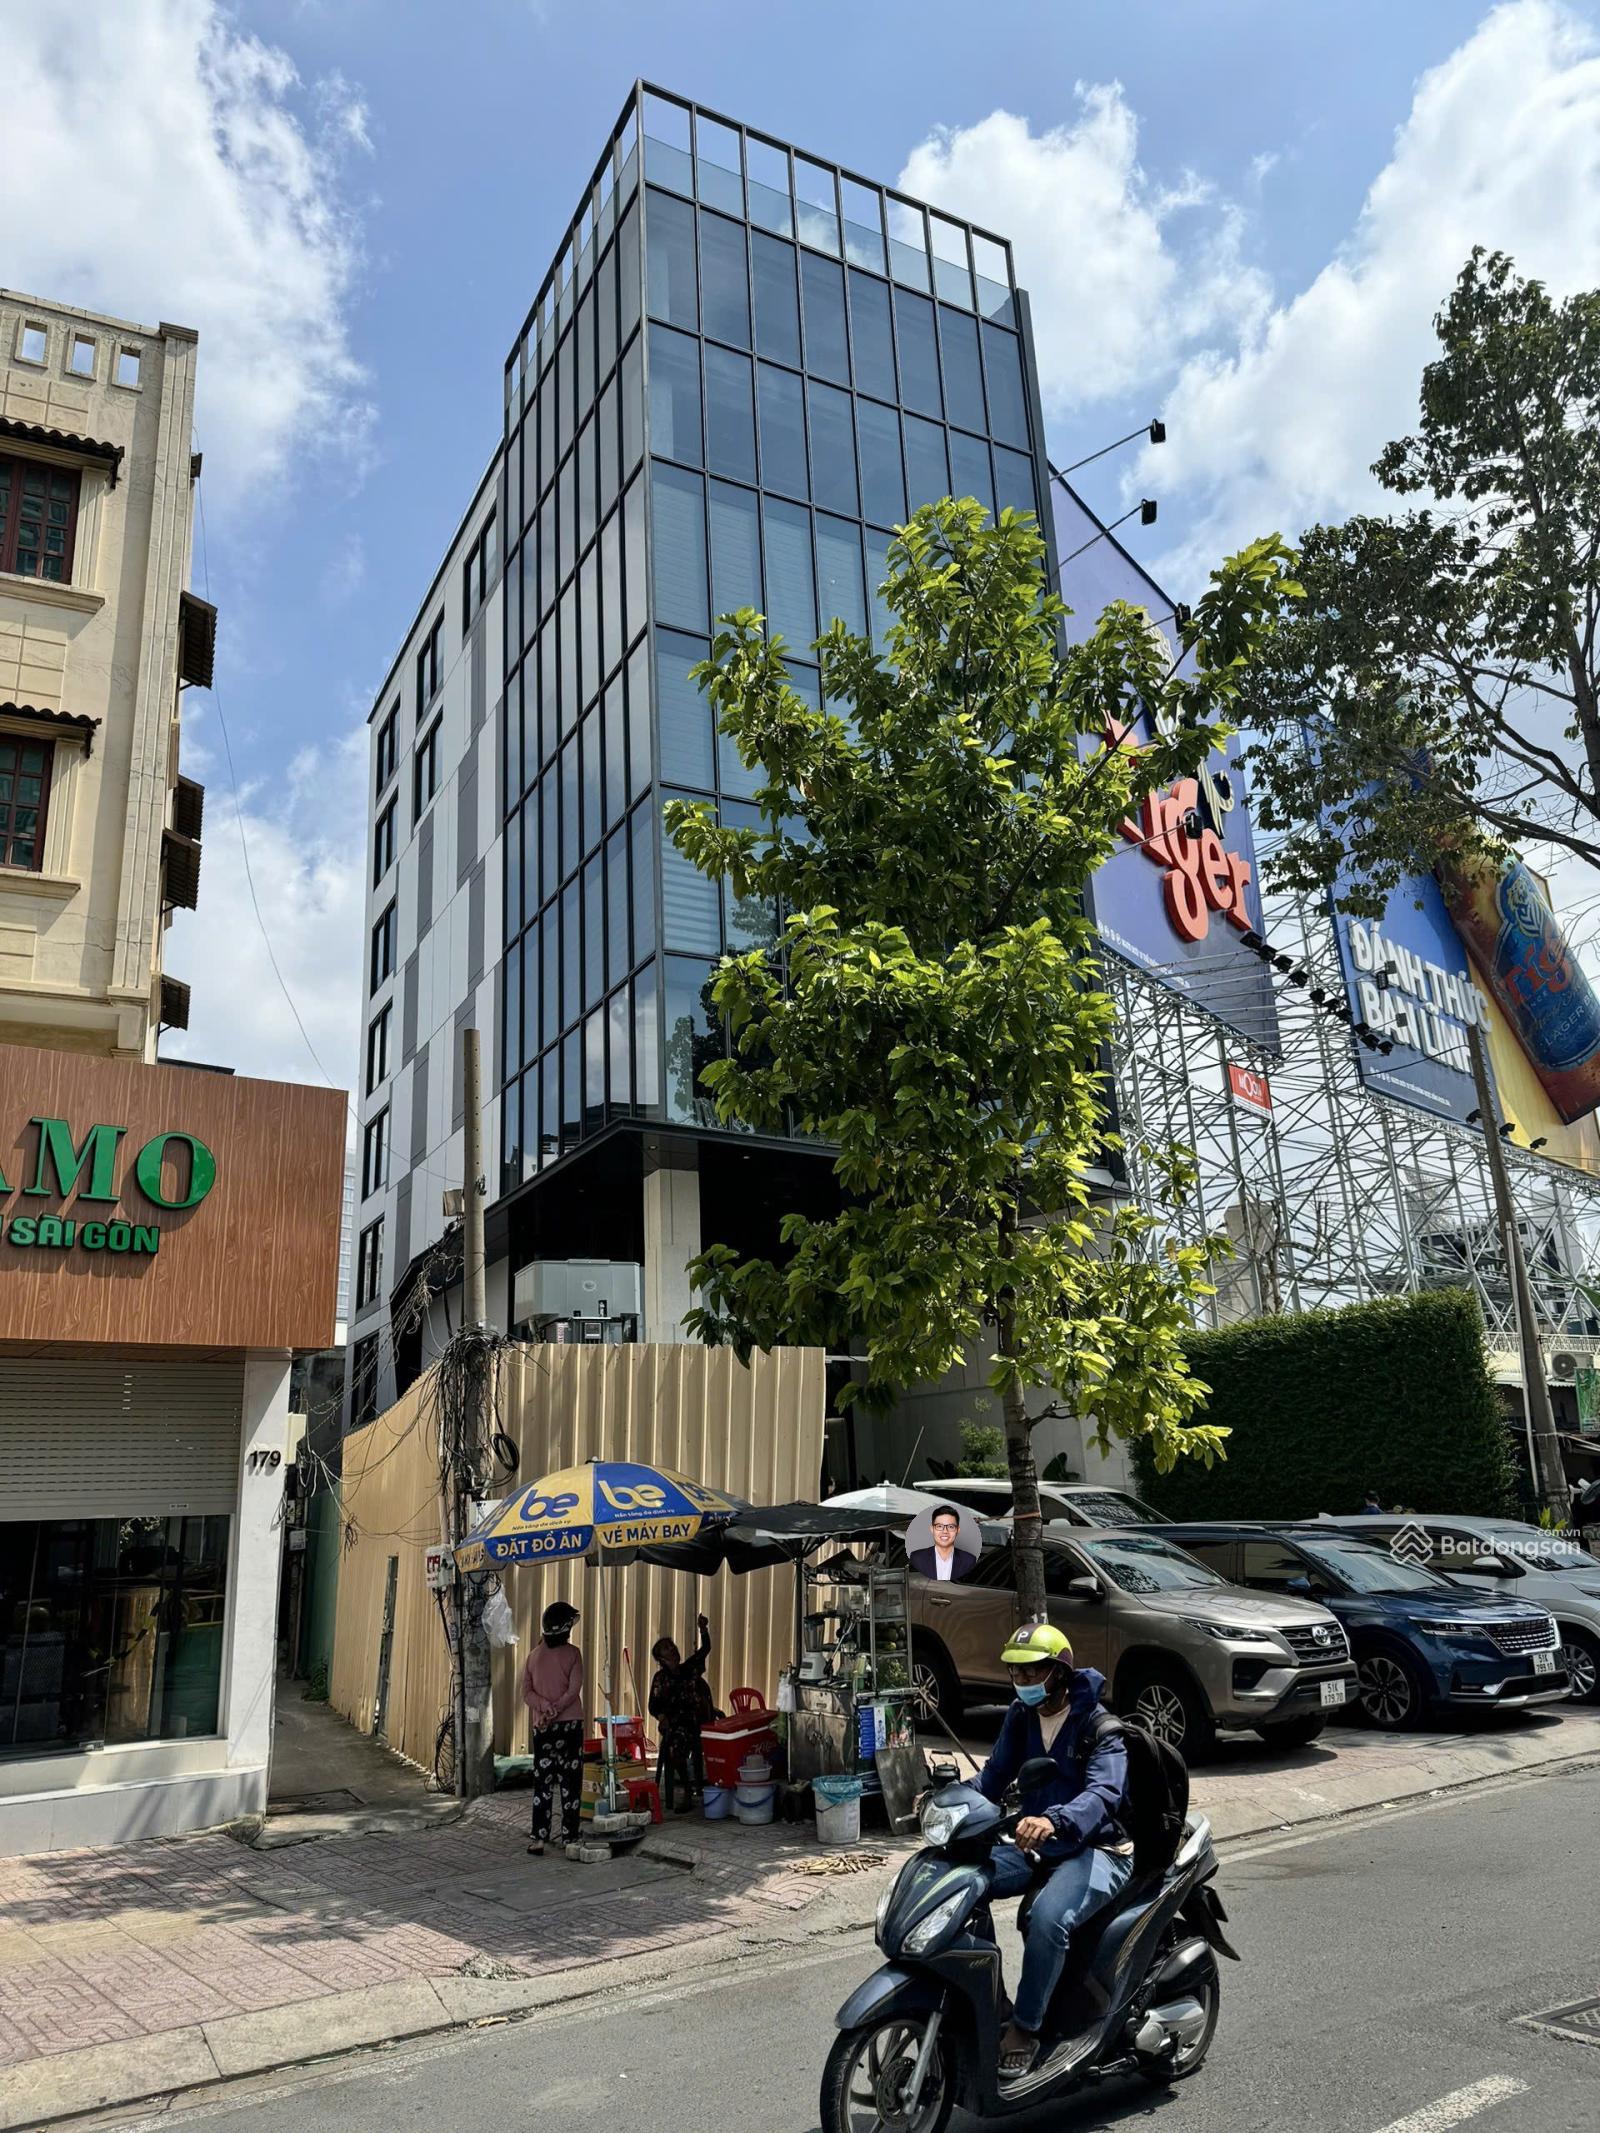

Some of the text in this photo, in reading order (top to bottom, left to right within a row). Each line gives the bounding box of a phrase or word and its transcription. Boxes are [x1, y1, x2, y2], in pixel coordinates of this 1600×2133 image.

[1348, 919, 1429, 1003] ĐÁNH
[1543, 1004, 1585, 1047] LAGER
[0, 1116, 217, 1209] MO
[250, 1450, 282, 1468] 179
[519, 1488, 580, 1522] be
[598, 1480, 667, 1511] be
[496, 1538, 528, 1559] ĐẶT
[531, 1530, 556, 1552] ĐỒ
[559, 1530, 582, 1549] ĂN
[603, 1522, 691, 1545] VÉ MÁY BAY
[1016, 1631, 1029, 1642] P
[1326, 1682, 1339, 1693] 51K
